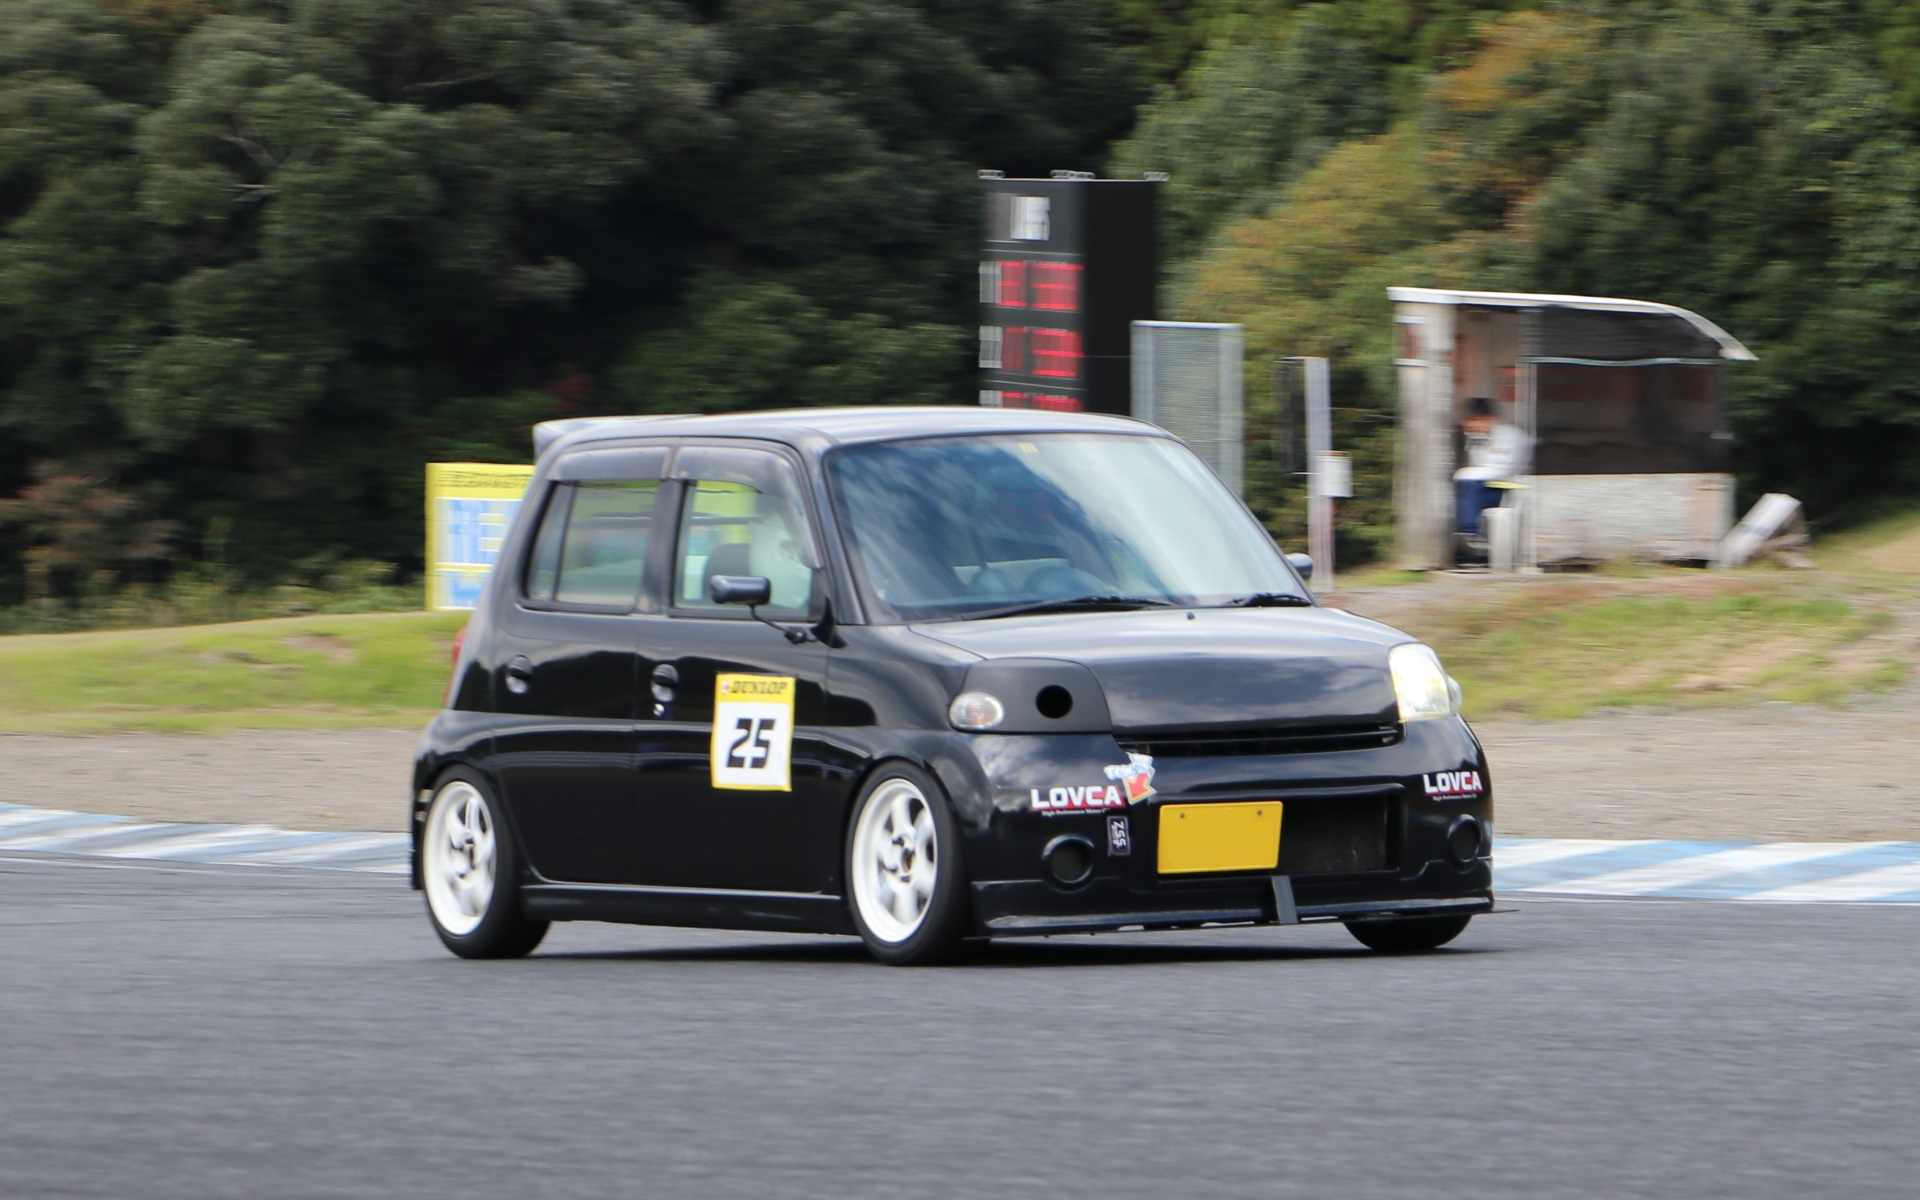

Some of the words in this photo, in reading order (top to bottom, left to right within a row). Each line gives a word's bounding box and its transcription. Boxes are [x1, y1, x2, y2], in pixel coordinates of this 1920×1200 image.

[731, 681, 788, 695] DUNLOP
[726, 717, 777, 769] 25
[1423, 771, 1483, 794] LOVCA
[1031, 785, 1122, 809] LOVCA
